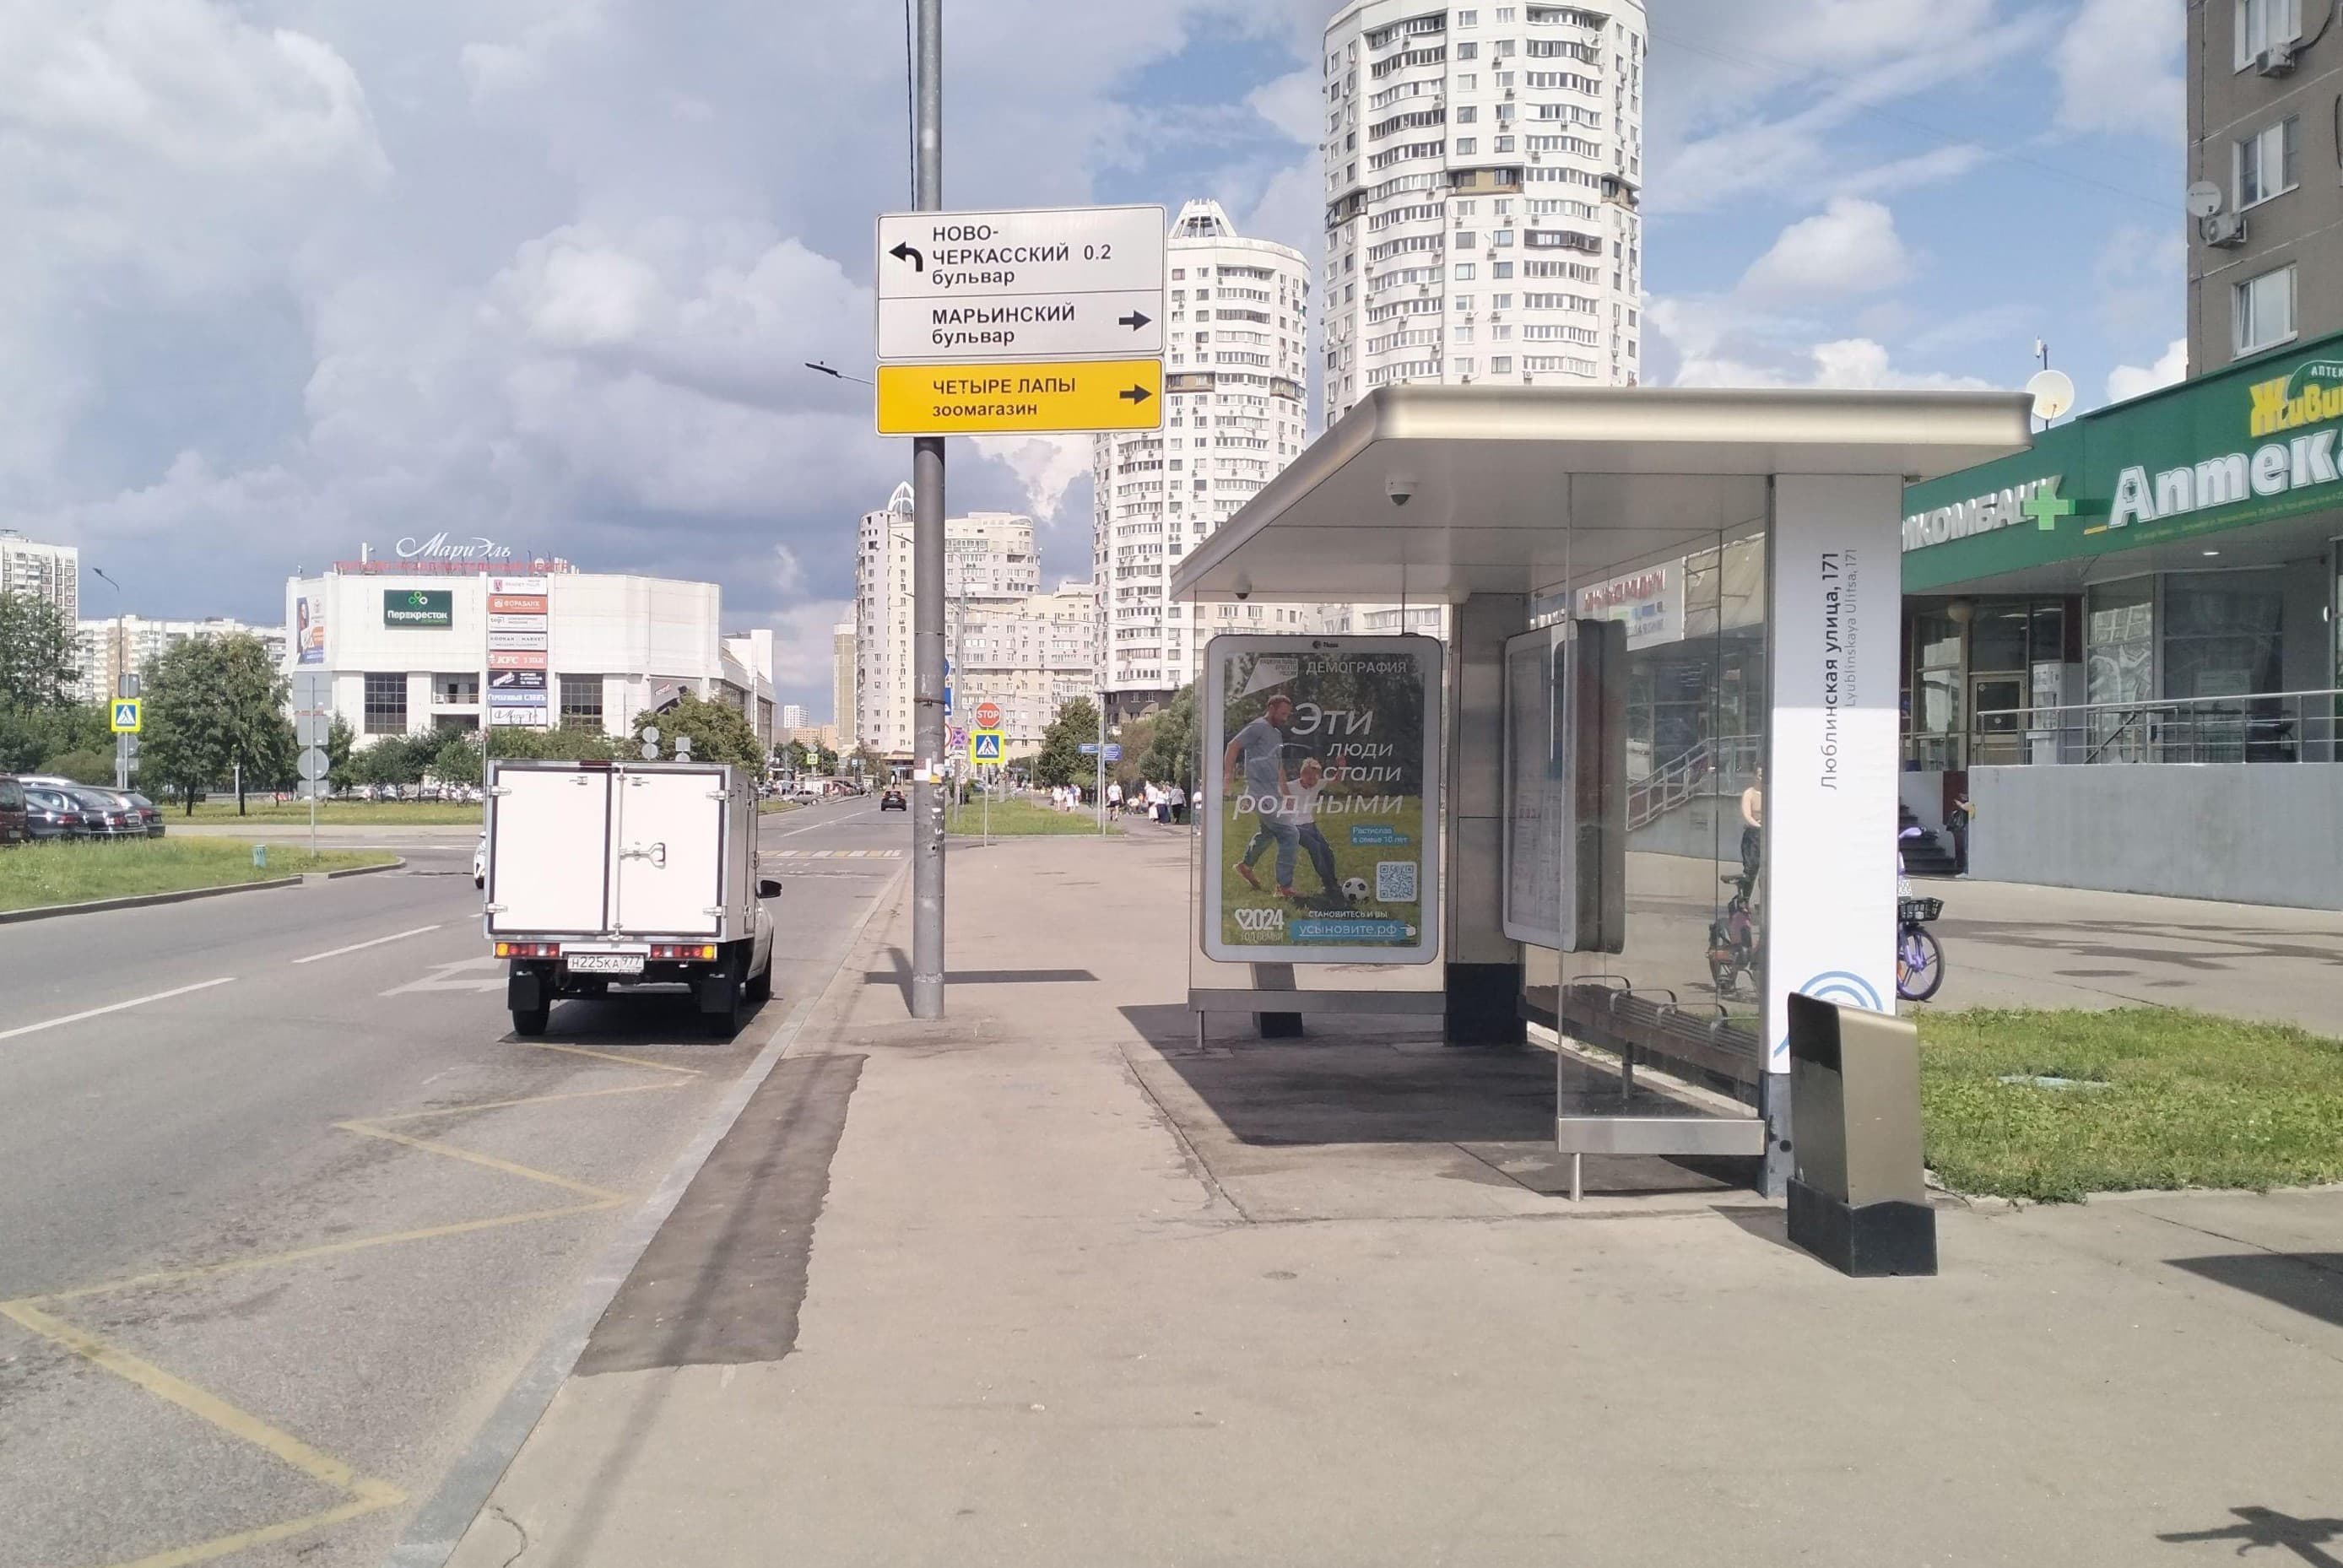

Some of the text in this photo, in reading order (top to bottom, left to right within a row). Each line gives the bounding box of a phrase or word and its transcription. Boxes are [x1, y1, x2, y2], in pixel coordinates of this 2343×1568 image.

[933, 225, 999, 242] НОВО-
[933, 243, 1112, 265] ЧЕРКАССКИЙ 0.2
[933, 269, 1015, 289] бульвар
[933, 302, 1075, 325] МАРЬИНСКИЙ
[933, 329, 1015, 348] бульвар
[933, 378, 1076, 395] ЧЕТЫРЕ ЛАПЫ
[933, 403, 1038, 418] зоомагазин
[2108, 429, 2343, 529] Аптек
[1845, 549, 1859, 706] Lyublinskaya Ulitsa, 171
[1306, 662, 1407, 676] ДЕМОГРАФИЯ
[1821, 554, 1842, 790] Люблинская улица, 171
[977, 711, 1000, 719] STOP
[1291, 702, 1374, 736] Эти
[1327, 743, 1393, 759] люди
[1323, 765, 1402, 781] стали
[1232, 793, 1404, 820] родными
[1242, 909, 1285, 931] 2024
[1299, 923, 1398, 936] усыновите.рф
